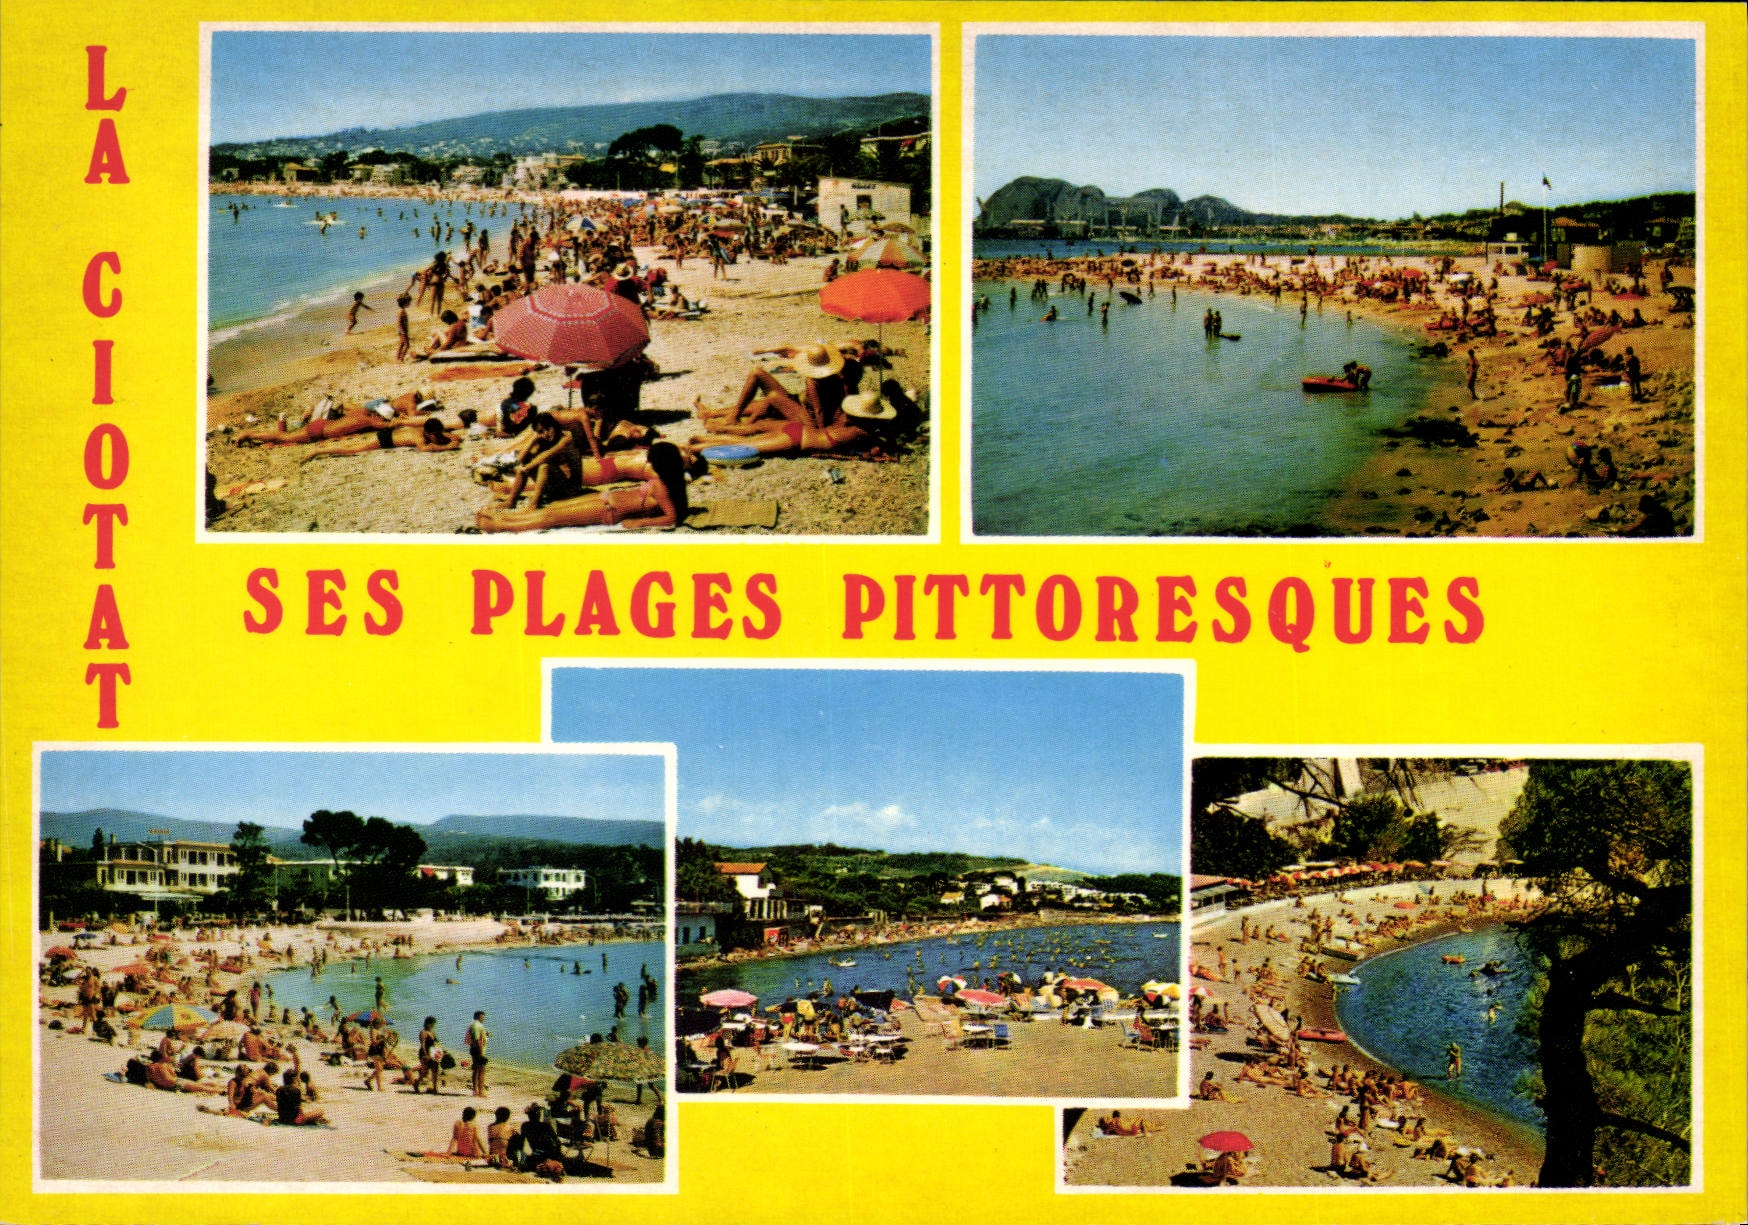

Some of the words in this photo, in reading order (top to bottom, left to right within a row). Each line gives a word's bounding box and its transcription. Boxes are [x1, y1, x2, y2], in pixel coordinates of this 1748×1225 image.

[84, 45, 129, 185] LA
[82, 251, 131, 729] CIOTAT
[243, 567, 403, 637] SES
[470, 570, 783, 641] PLAGES
[842, 573, 1484, 653] PITTORESQUES
